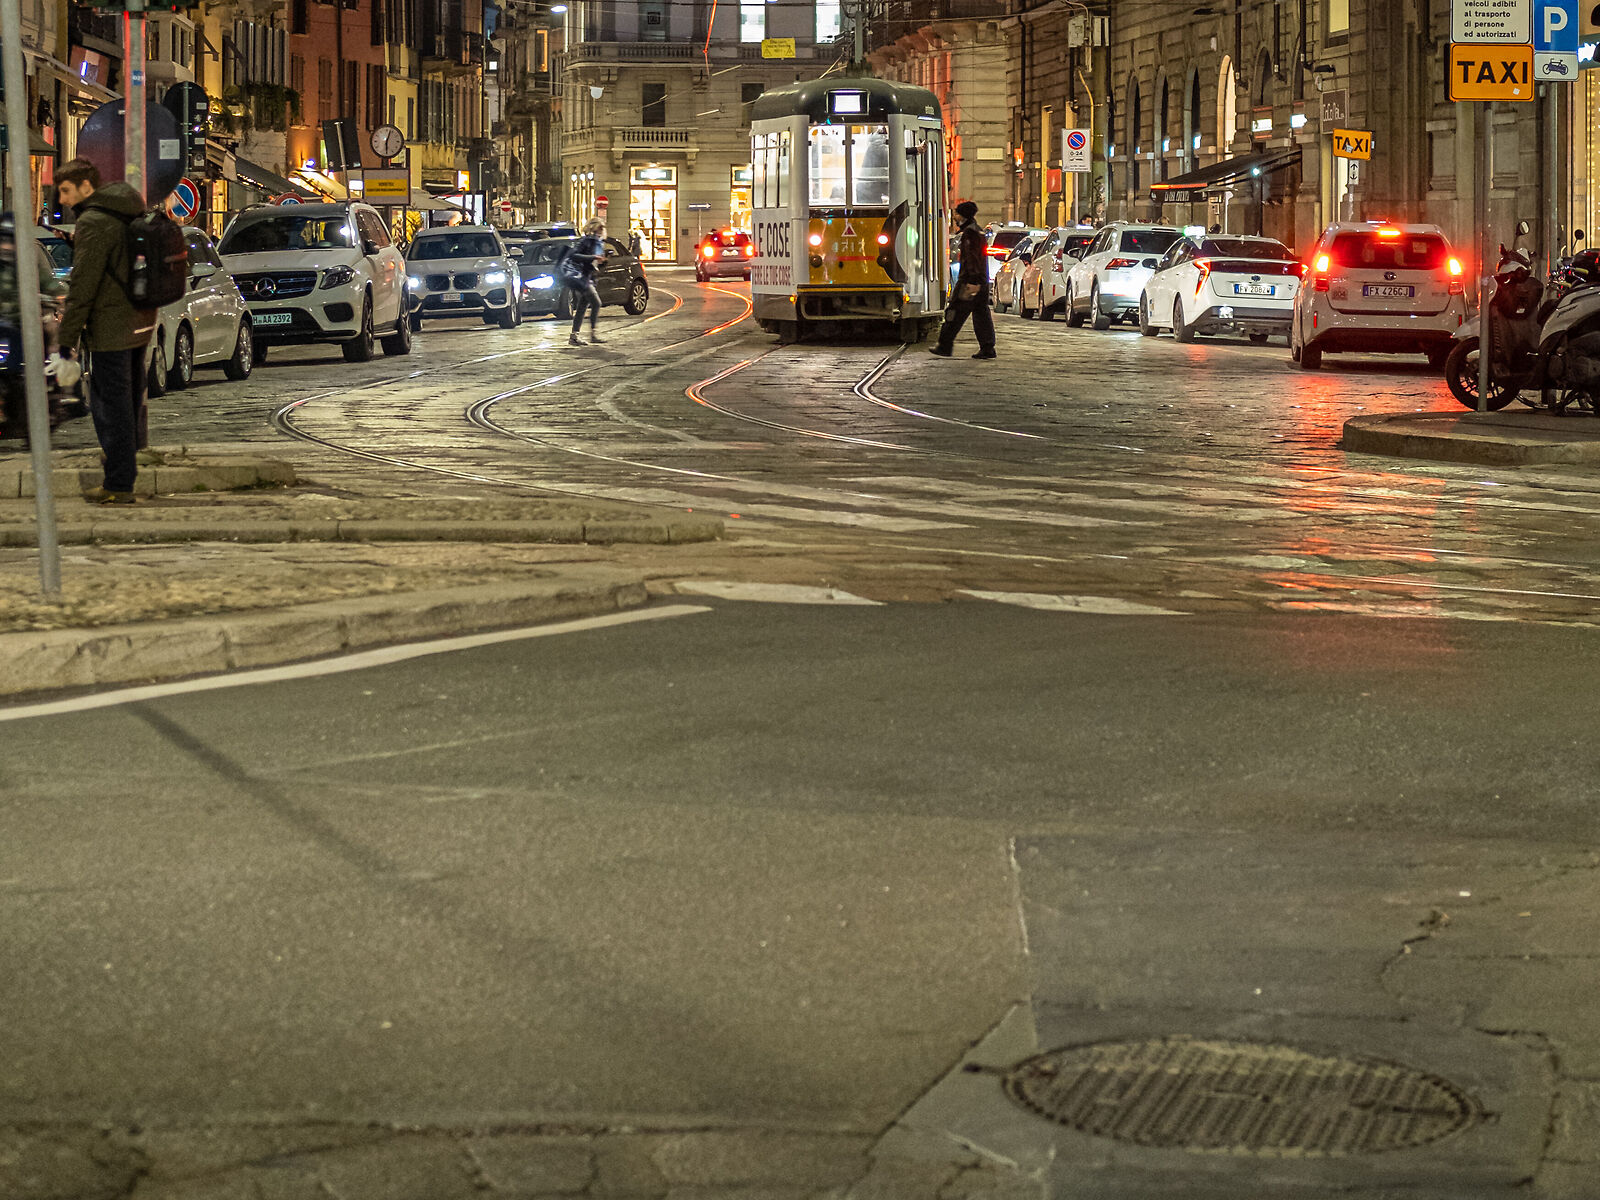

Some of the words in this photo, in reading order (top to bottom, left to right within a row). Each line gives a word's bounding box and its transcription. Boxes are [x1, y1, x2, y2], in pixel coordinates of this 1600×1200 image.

[1464, 0, 1490, 8] veicoli
[1492, 0, 1517, 8] adibiti
[1464, 10, 1472, 18] al
[1474, 10, 1511, 19] trasporto
[1464, 20, 1472, 28] di
[1474, 21, 1505, 29] persone
[1544, 6, 1568, 43] P
[1457, 61, 1528, 84] TAXI
[1335, 136, 1368, 153] TAXI
[753, 222, 764, 257] LE
[766, 222, 790, 257] COSE
